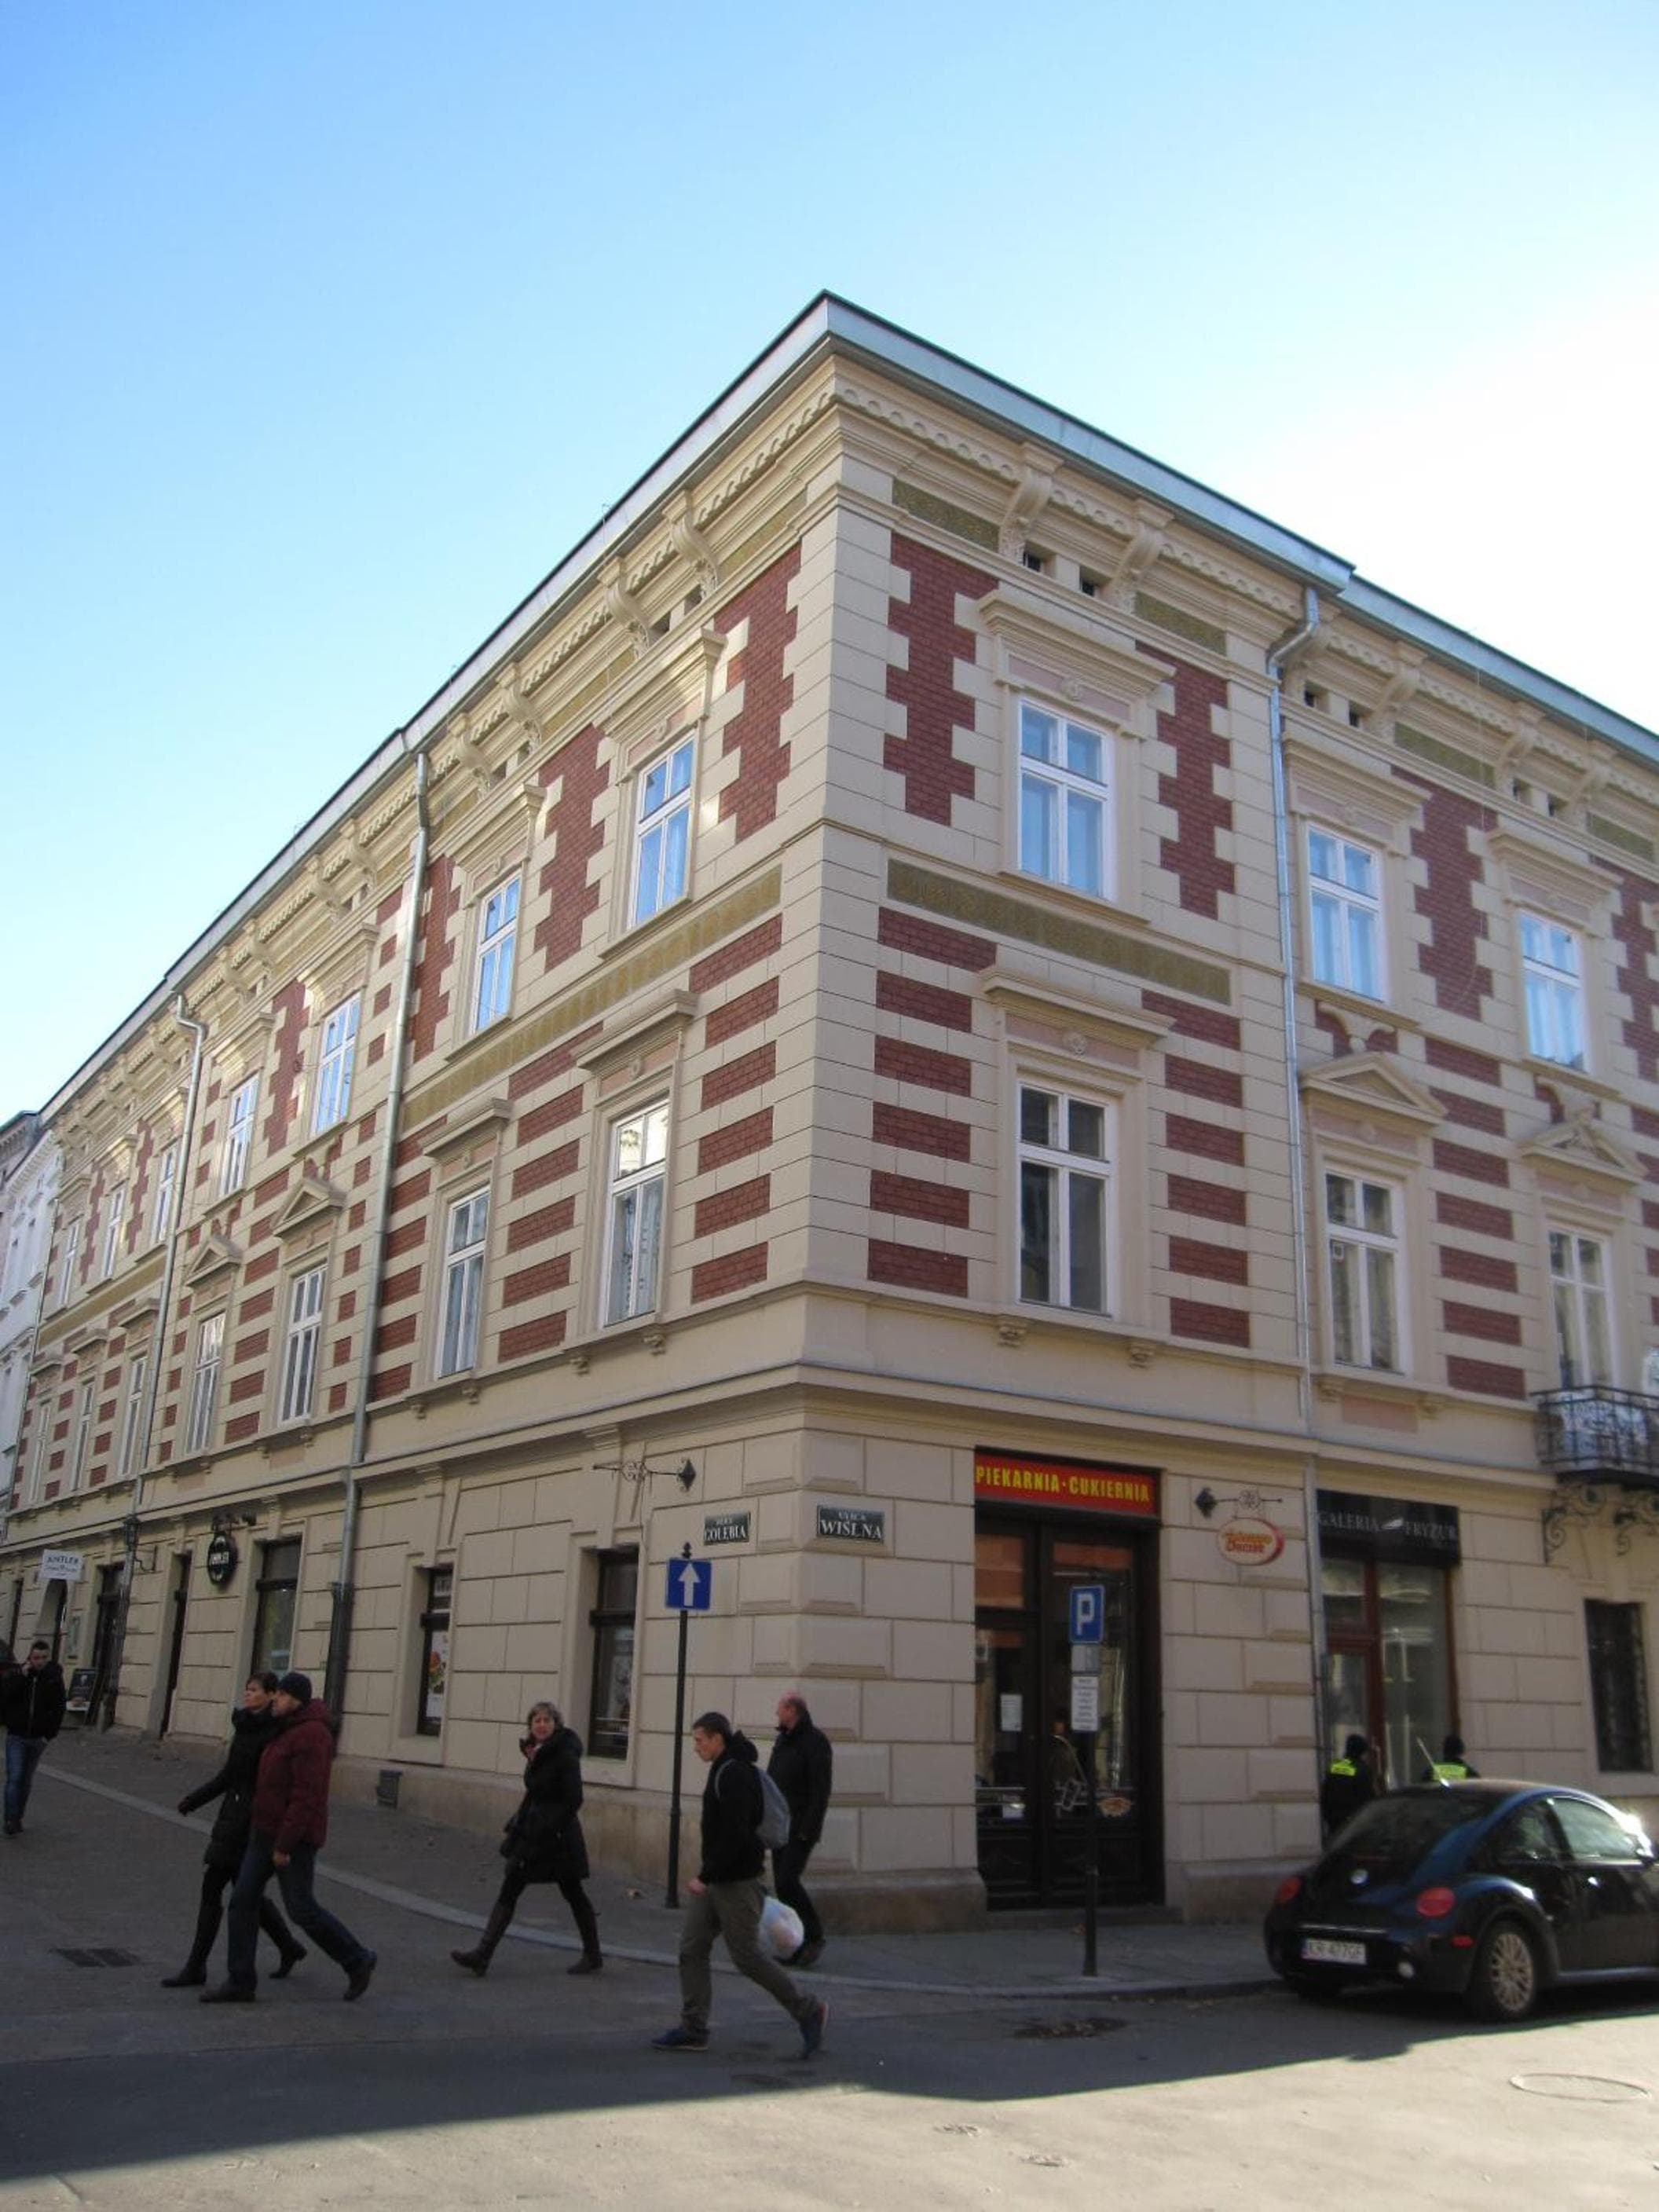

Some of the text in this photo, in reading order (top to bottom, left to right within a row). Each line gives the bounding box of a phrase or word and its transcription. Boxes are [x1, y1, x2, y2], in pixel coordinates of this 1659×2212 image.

[976, 1466, 1150, 1502] PIEKARNIA CUKIERNIA
[1076, 1593, 1095, 1635] P
